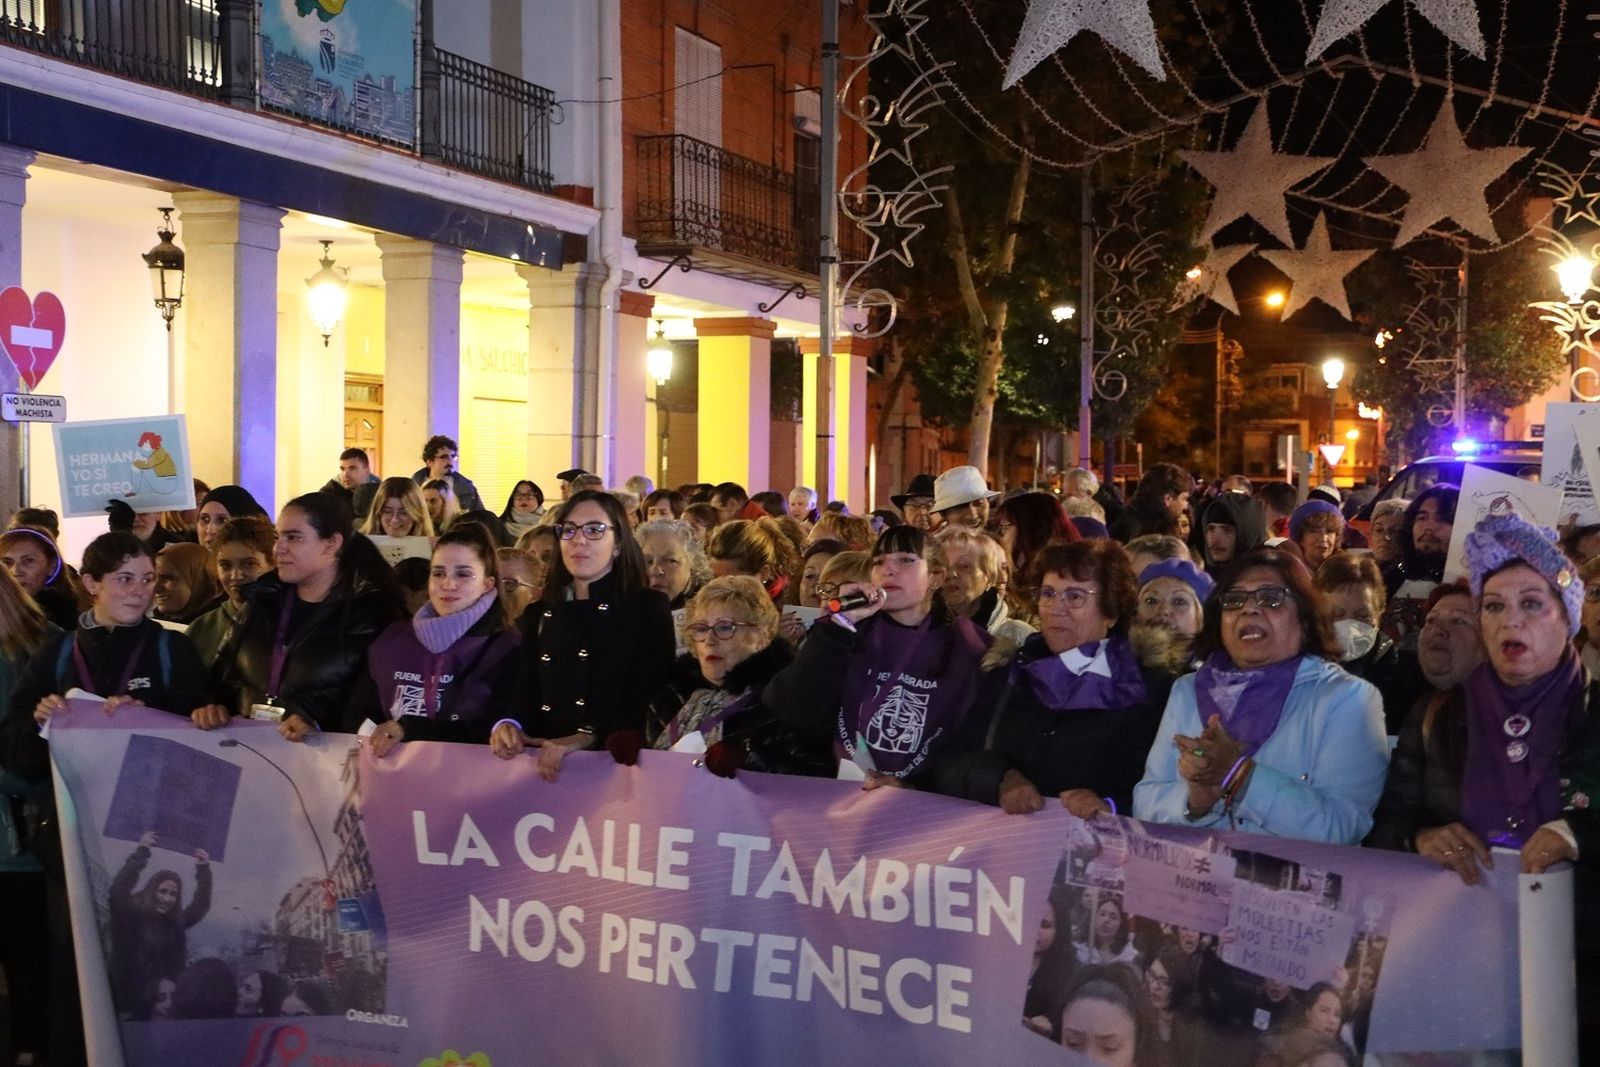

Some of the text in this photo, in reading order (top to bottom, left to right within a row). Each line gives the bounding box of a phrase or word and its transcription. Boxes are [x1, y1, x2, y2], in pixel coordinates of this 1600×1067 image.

[6, 396, 62, 407] NO VIOLENCIA
[15, 409, 53, 418] MACHISTA
[70, 467, 92, 482] YO
[71, 481, 133, 497] TE CREO
[412, 810, 1025, 945] LA CALLE TAMBIÉN
[1175, 873, 1218, 897] NORMAL
[1237, 905, 1325, 945] MOLESTIAS
[1312, 910, 1334, 929] LAS
[469, 894, 973, 1033] NOS PERTENECE
[346, 1008, 408, 1028] ORGANIZA
